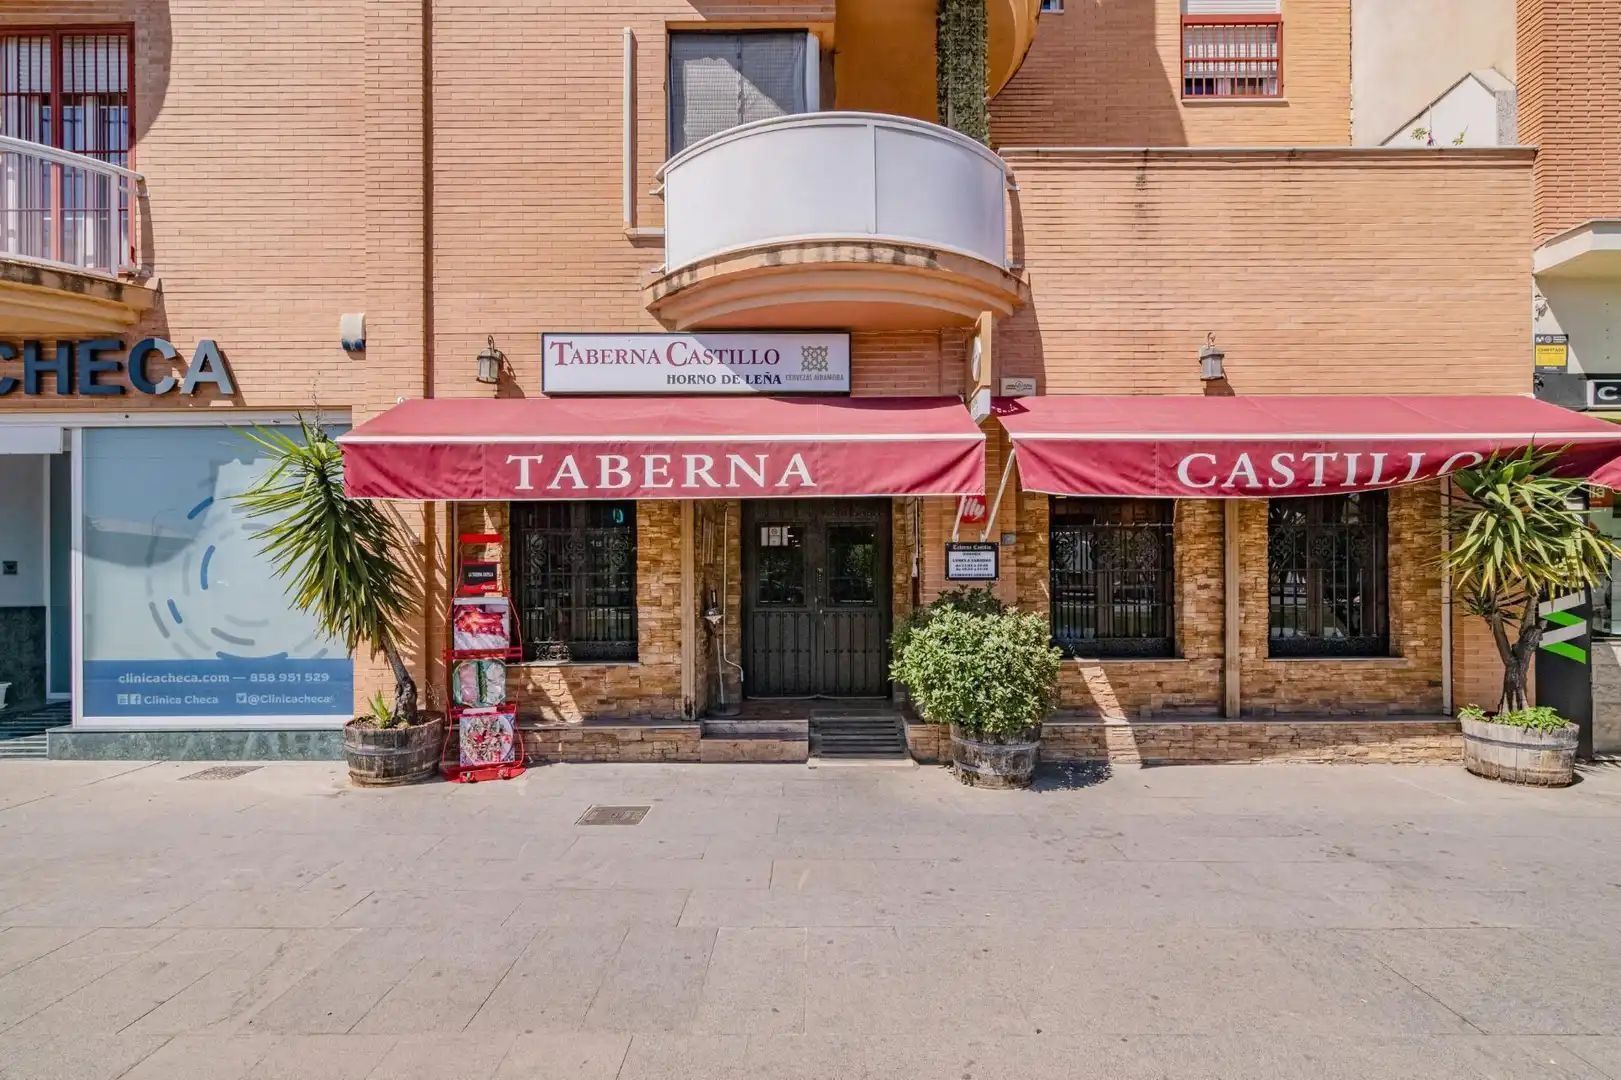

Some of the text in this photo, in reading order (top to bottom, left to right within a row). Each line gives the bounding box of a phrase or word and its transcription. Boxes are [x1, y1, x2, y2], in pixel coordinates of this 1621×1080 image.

[549, 341, 780, 367] TABERNA CASTILLO
[666, 371, 782, 385] HORNO DE LEÑA
[505, 452, 817, 490] TABERNA
[118, 673, 230, 684] clinicacheca.com
[250, 672, 276, 682] 858
[278, 672, 301, 682] 951
[304, 672, 330, 682] 529
[184, 695, 219, 705] Checa
